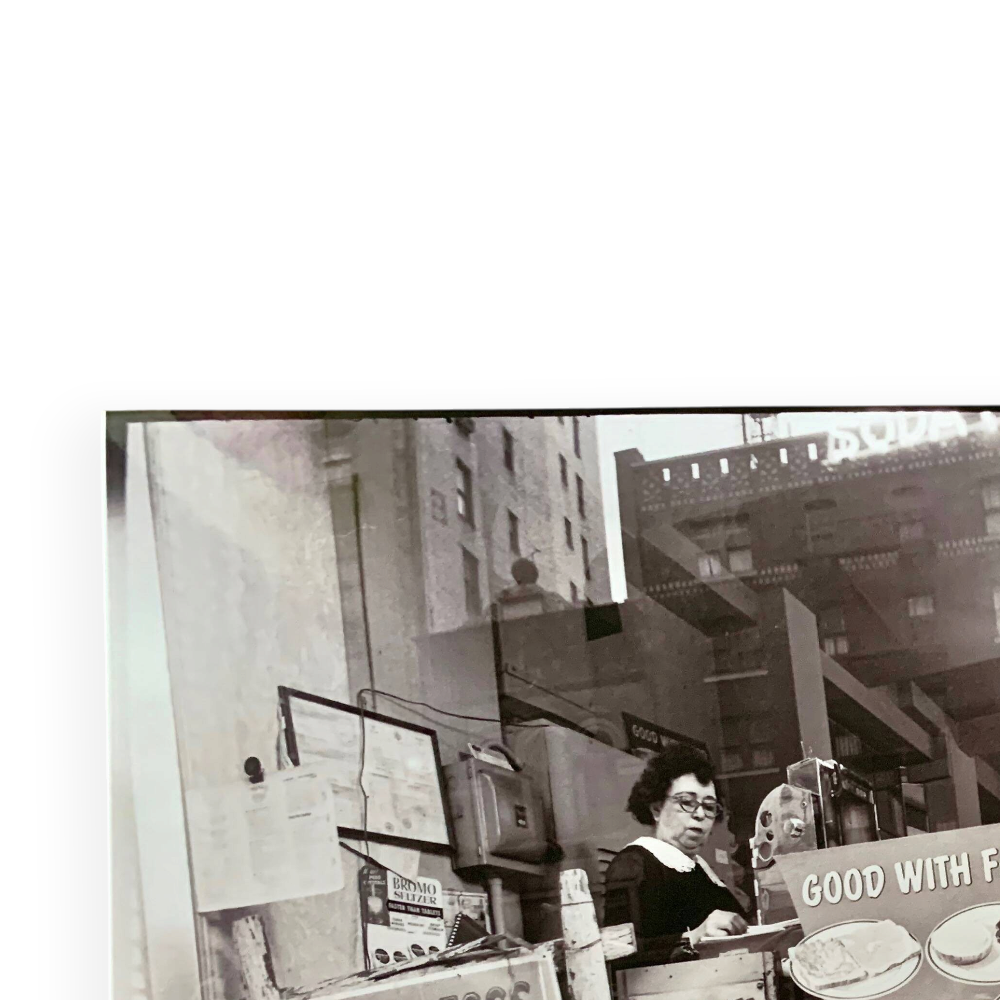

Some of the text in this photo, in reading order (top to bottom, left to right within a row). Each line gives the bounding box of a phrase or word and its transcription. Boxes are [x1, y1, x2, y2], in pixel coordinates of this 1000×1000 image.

[393, 877, 437, 895] BROMO
[802, 864, 885, 907] GOOD
[894, 852, 972, 894] WITH
[394, 891, 437, 905] SELTZER
